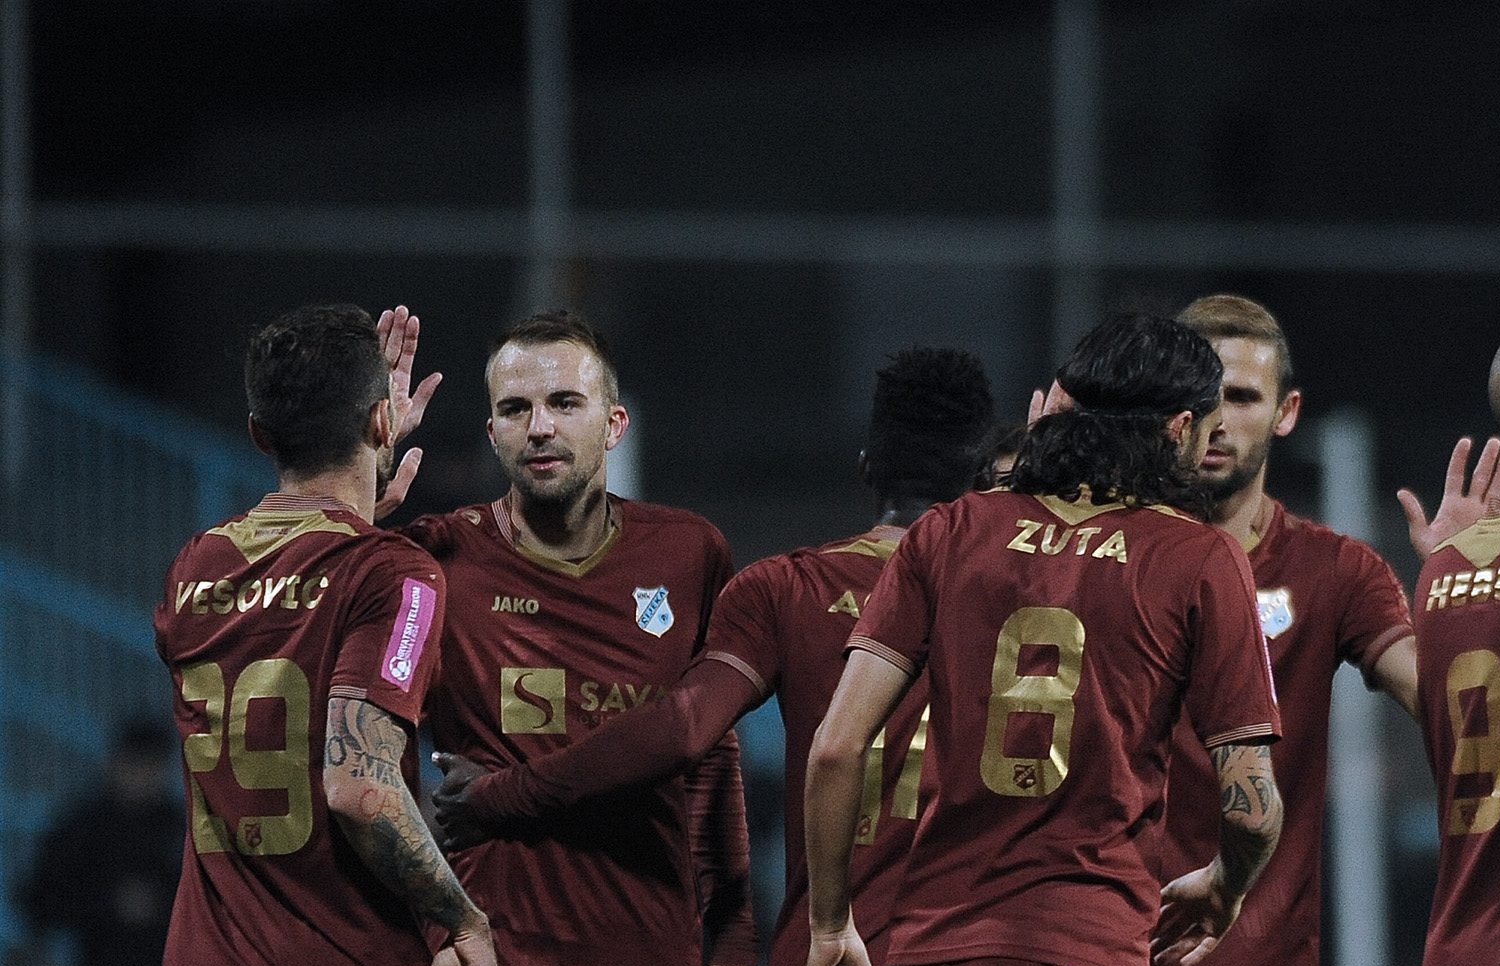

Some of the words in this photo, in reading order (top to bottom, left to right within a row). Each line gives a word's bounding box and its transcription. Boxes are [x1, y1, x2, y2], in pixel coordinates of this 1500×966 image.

[1006, 518, 1128, 564] ZUTA
[491, 595, 540, 615] JAKO
[180, 658, 314, 857] 29
[979, 606, 1087, 797] 8
